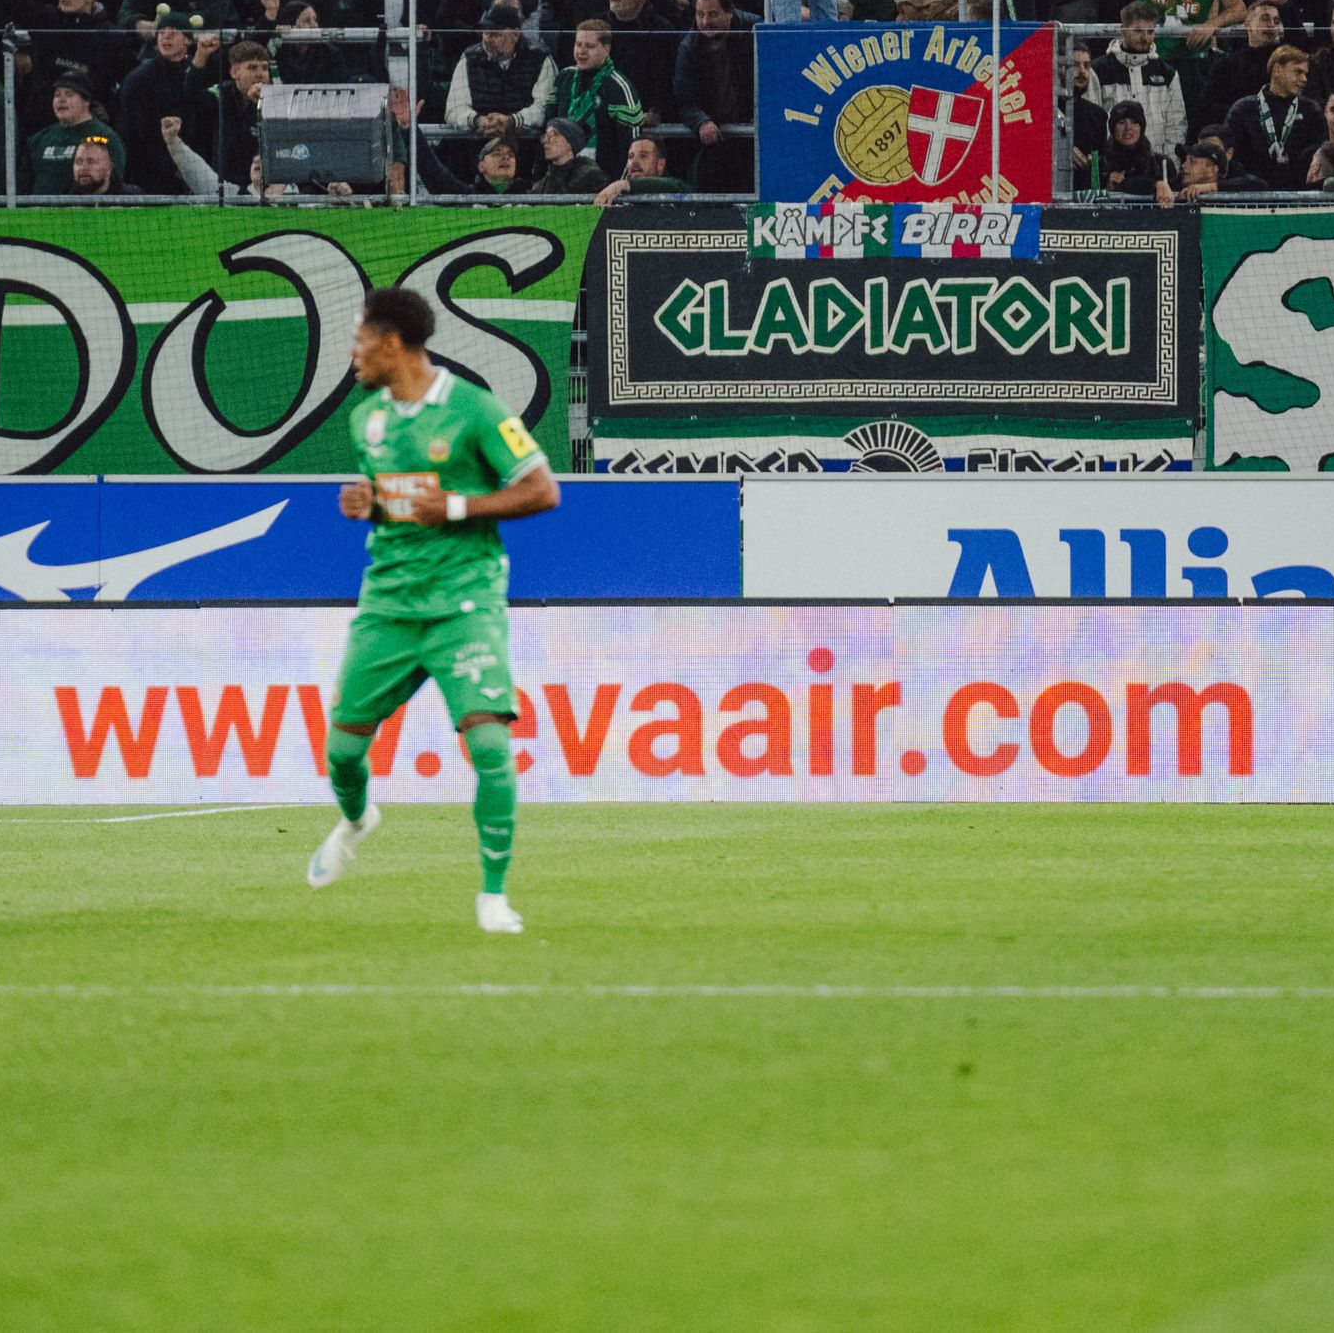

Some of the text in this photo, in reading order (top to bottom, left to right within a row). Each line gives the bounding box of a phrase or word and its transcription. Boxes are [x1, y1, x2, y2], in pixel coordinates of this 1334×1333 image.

[784, 25, 1033, 127] 1. Wiener Arbeiter
[866, 121, 904, 160] 1897
[753, 208, 1024, 248] KÄMPFE BIRRI
[654, 275, 1131, 357] GLADIATORI
